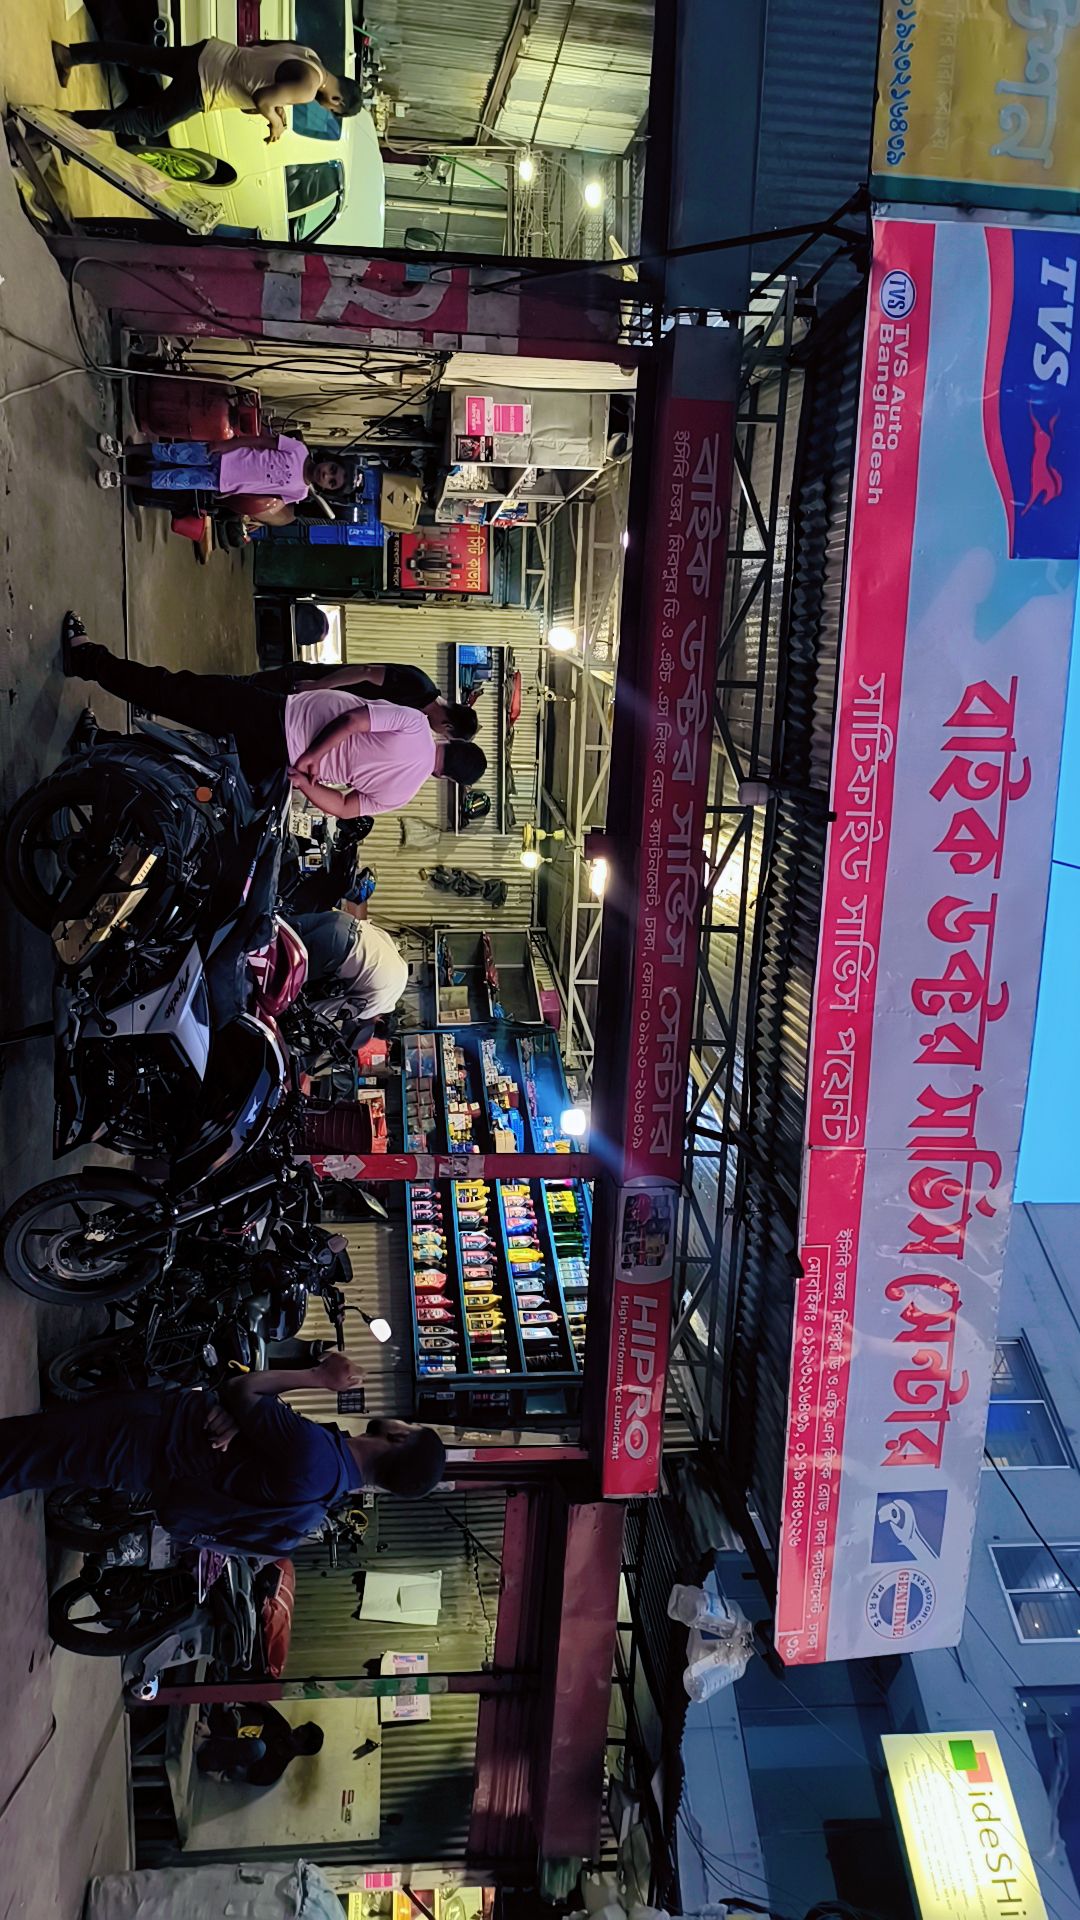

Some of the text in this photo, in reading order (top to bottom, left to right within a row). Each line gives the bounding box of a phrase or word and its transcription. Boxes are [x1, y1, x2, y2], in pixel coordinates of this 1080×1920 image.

[886, 278, 907, 310] TVS
[1032, 256, 1077, 386] TVS
[886, 323, 910, 450] TVS Auto
[867, 323, 894, 505] Bangladesh
[672, 431, 691, 478] ইসিবি
[466, 536, 486, 555] সিট
[662, 534, 685, 594] মিরপুর
[465, 558, 481, 591] কাভার
[653, 723, 672, 765] লিংক
[648, 433, 721, 1157] বাইক ডক্টর সার্ভিস সেন্টার
[819, 673, 893, 1142] সার্টিফাইড সার্ভিস পয়েন্ট
[107, 1069, 115, 1086] TVS
[879, 676, 1032, 1468] বাইক ডক্টর সার্ভিস সেন্টার
[835, 1228, 854, 1268] ইসিবি
[826, 1309, 848, 1352] মিরপুর
[611, 1296, 630, 1460] High Performance Lubricant
[625, 1296, 658, 1460] HIPRO
[819, 1447, 837, 1479] লিংক
[788, 1442, 806, 1548] ০১৭৯৭৪৪৩২২৬
[813, 1519, 828, 1546] ঢাকা
[868, 1584, 885, 1628] PARTS
[892, 1571, 910, 1637] GENUINE
[912, 1573, 926, 1587] TVS
[921, 1586, 932, 1619] MOTOR
[786, 1635, 801, 1660] ৩৯
[968, 1791, 1027, 1916] ideSHi
